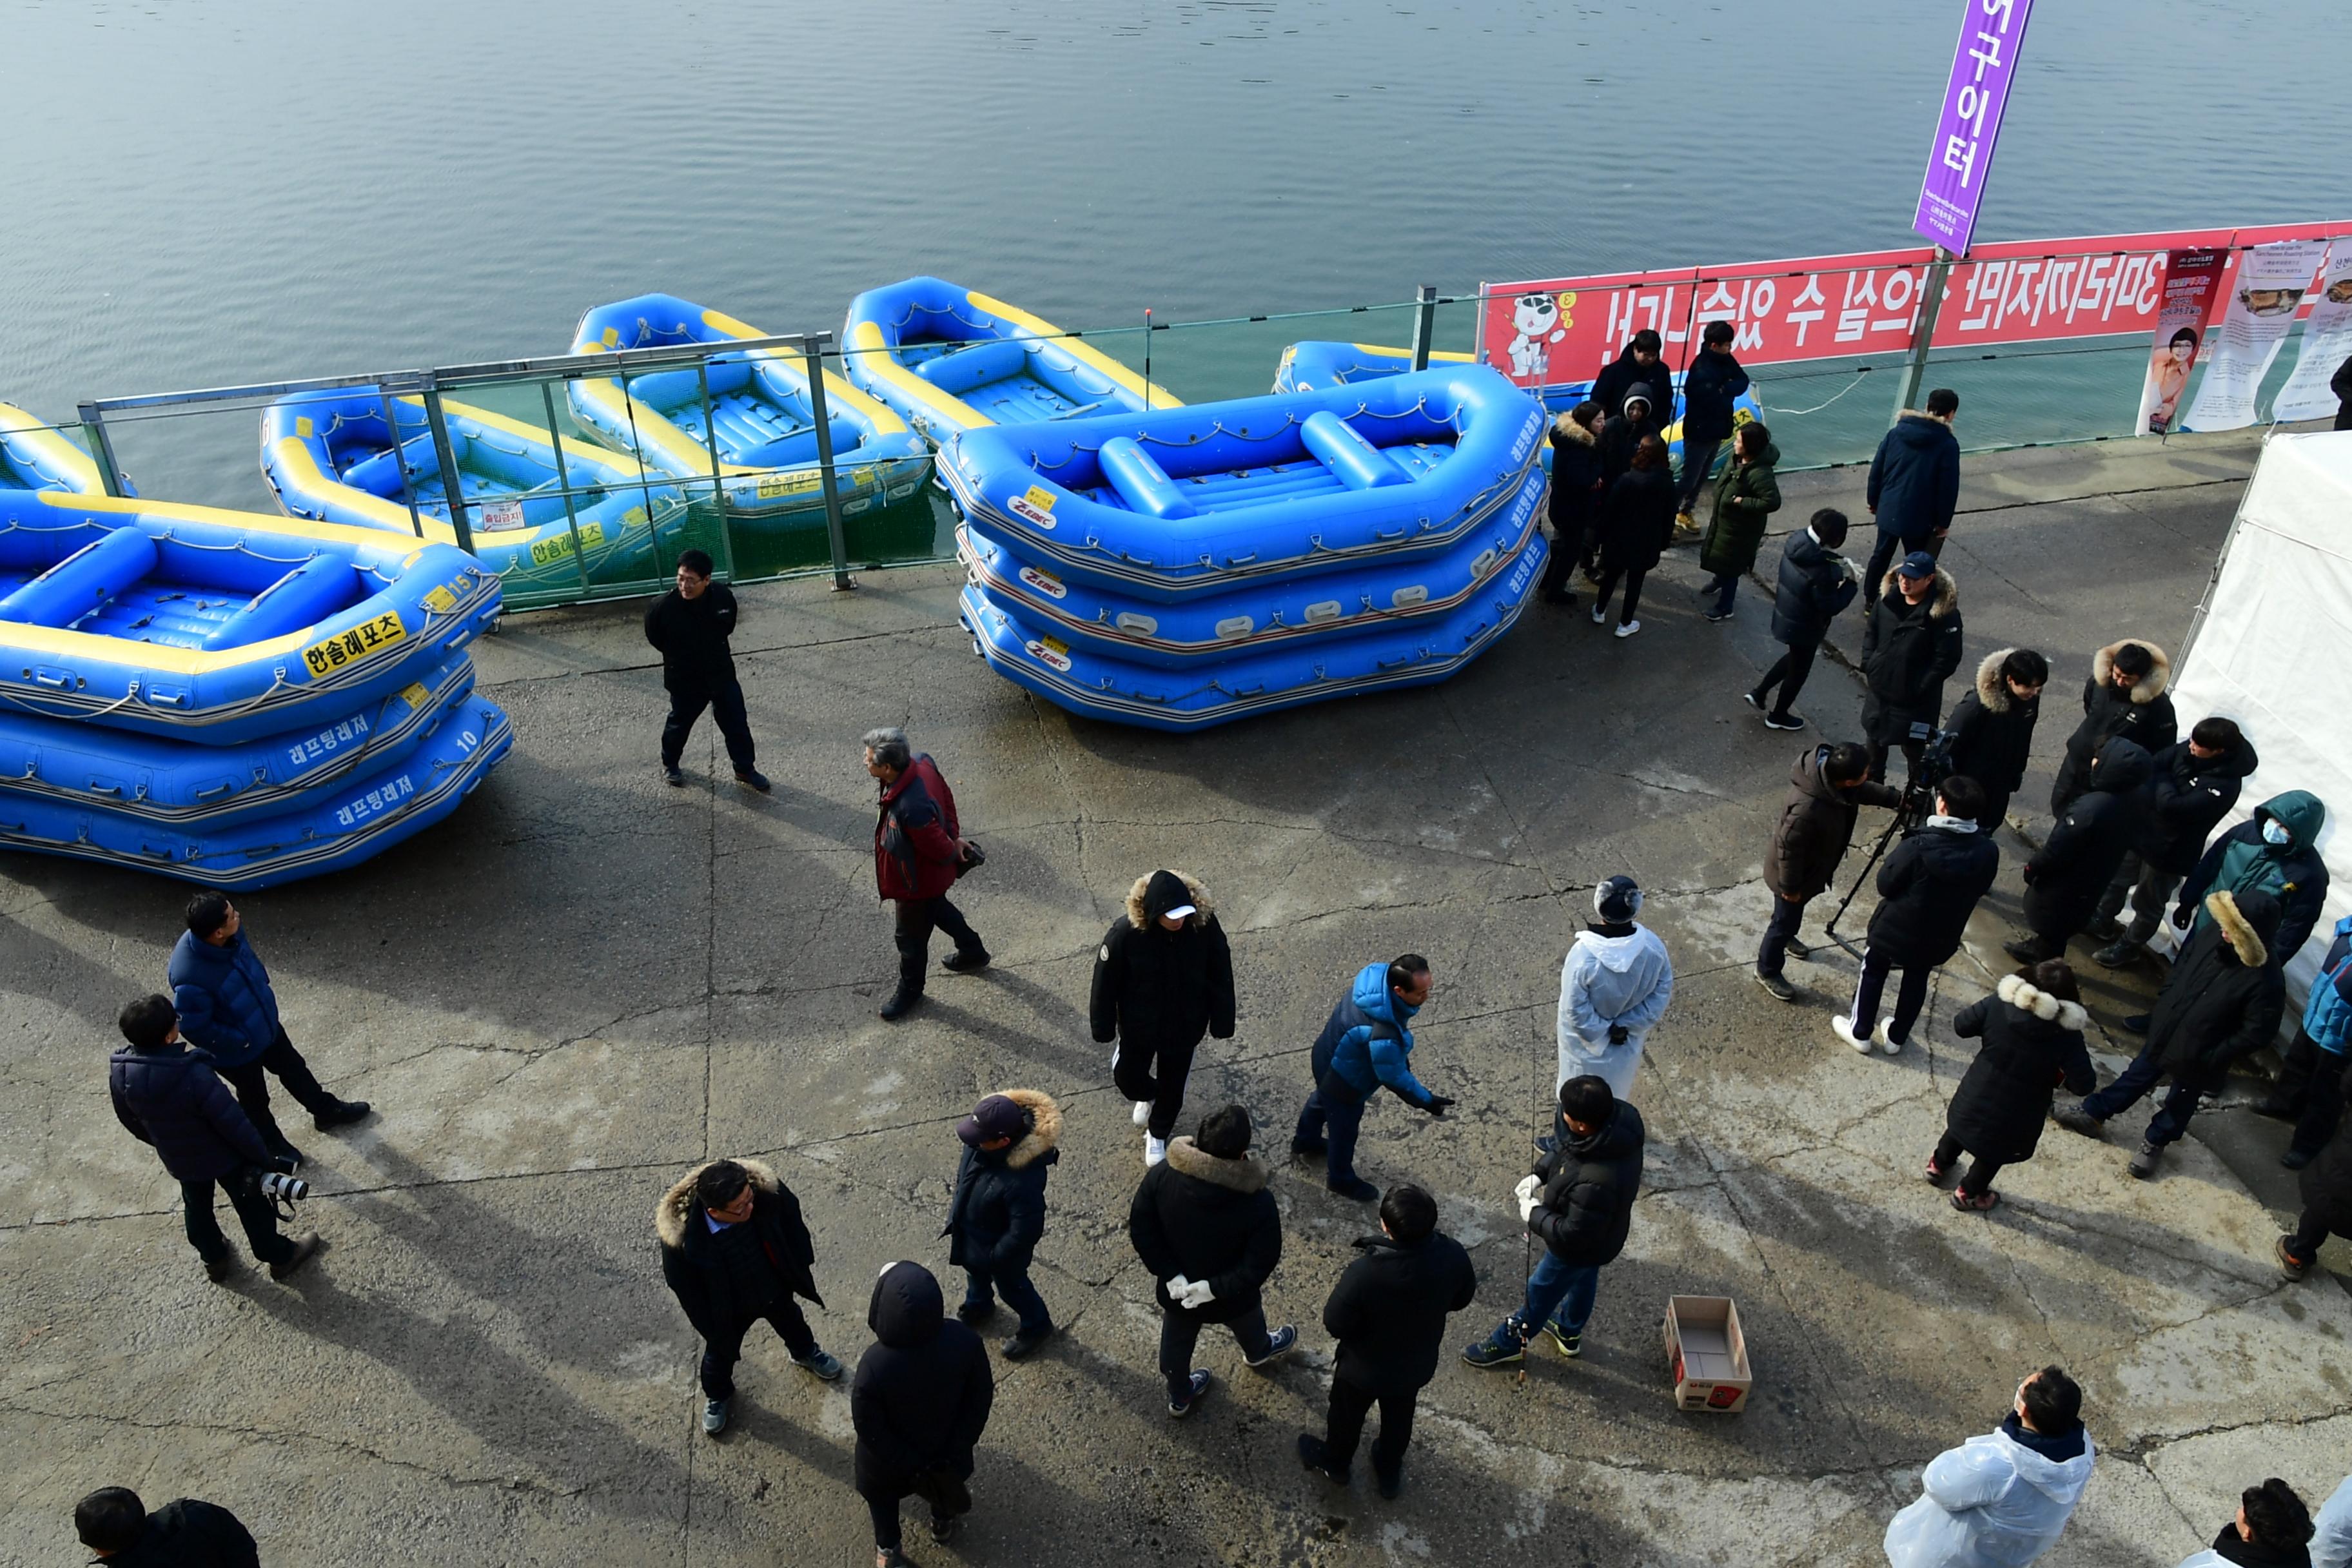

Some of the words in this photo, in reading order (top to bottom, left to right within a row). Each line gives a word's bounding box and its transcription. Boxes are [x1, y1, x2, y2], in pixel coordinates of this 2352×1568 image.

[1013, 499, 1053, 526] ZEBEC
[449, 574, 471, 596] 15
[1025, 569, 1063, 596] ZEBEC
[306, 615, 402, 674] 한솔레포츠
[456, 730, 478, 753] 10
